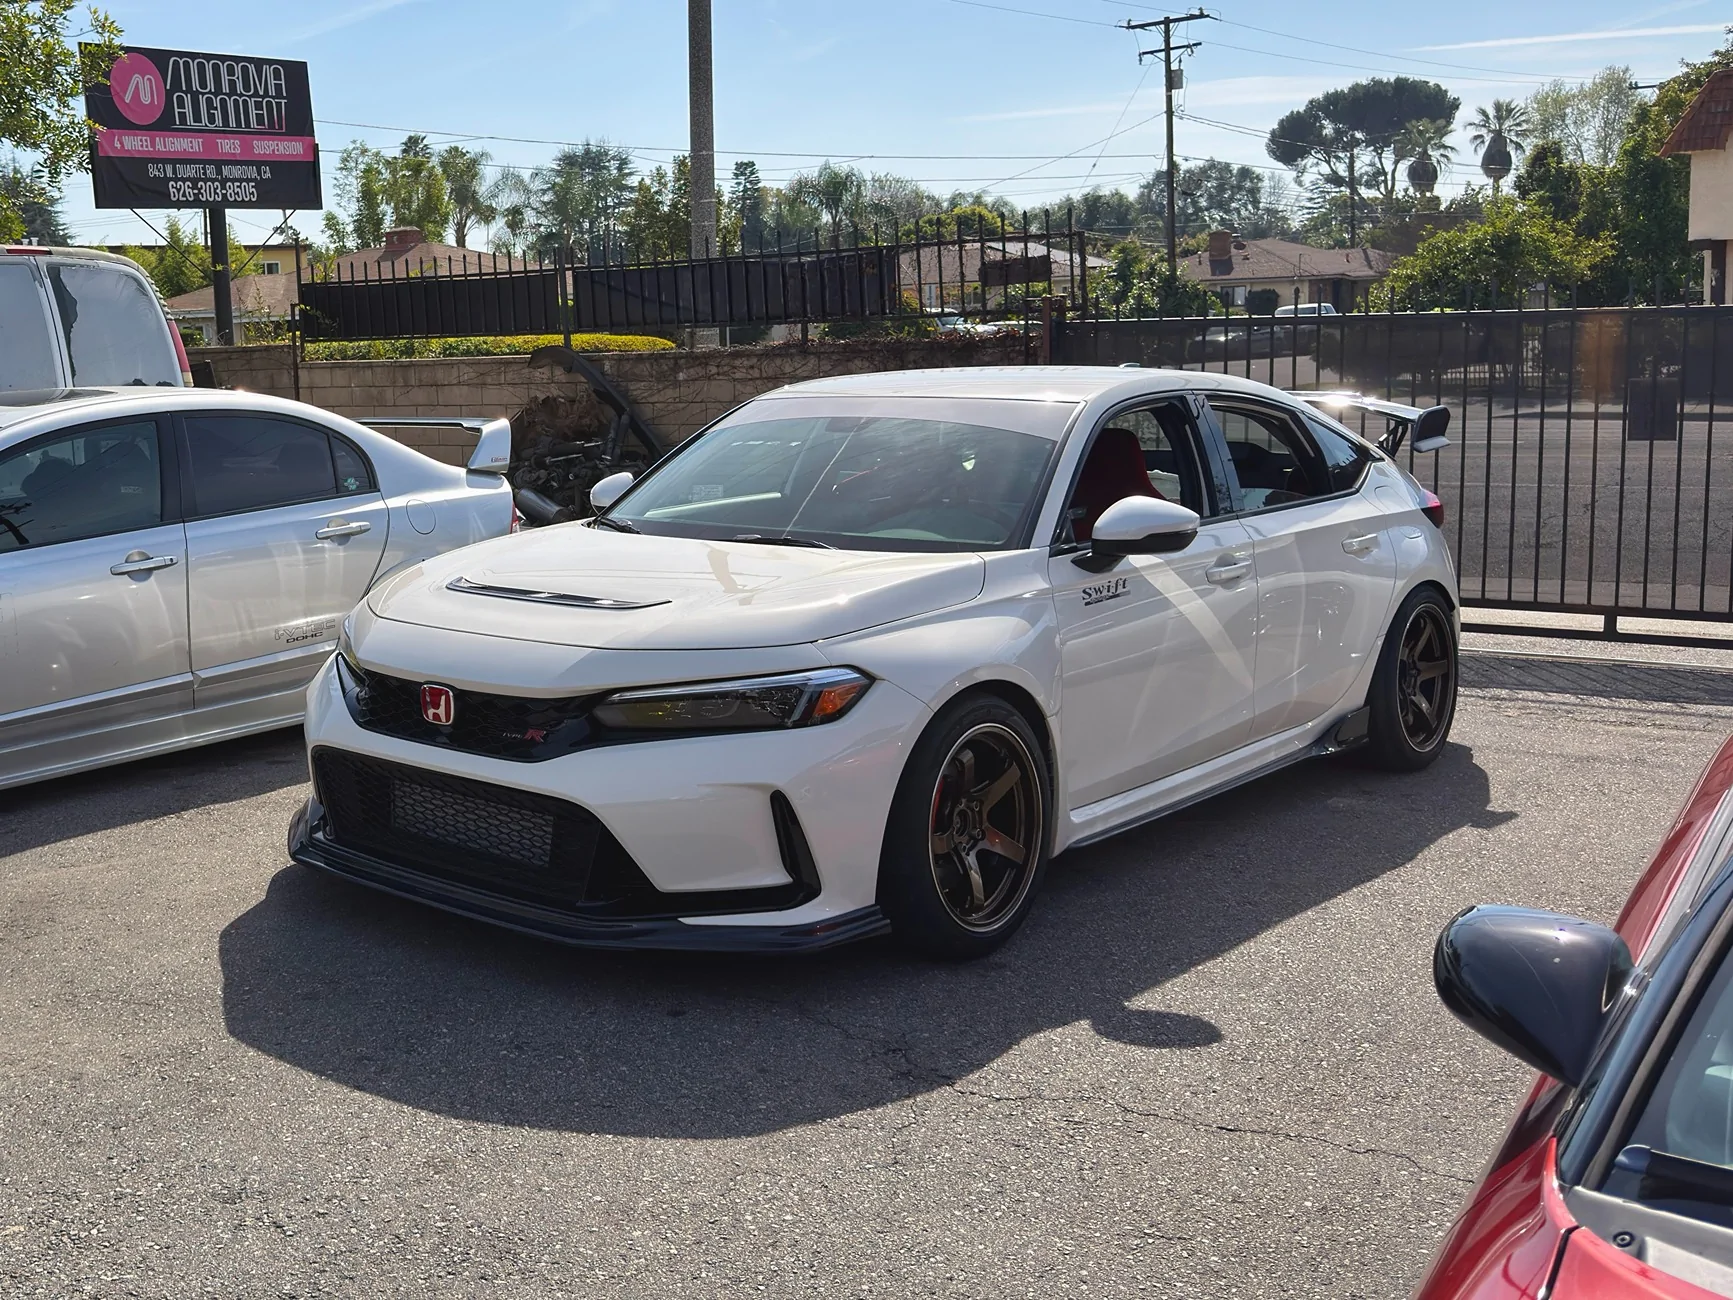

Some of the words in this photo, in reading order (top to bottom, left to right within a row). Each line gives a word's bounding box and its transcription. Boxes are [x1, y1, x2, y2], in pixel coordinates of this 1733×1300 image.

[166, 56, 287, 97] MONROVIA
[172, 92, 288, 132] ALIGNMENT
[114, 135, 121, 149] 4
[122, 136, 153, 151] WHEEL
[155, 137, 203, 153] ALIGNMENT
[216, 139, 241, 154] TIRES
[253, 140, 304, 155] SUSPENSION
[148, 163, 164, 178] 843
[165, 164, 175, 178] W.
[176, 164, 205, 178] DUARTE
[222, 165, 260, 181] MONROVIA,
[261, 166, 272, 179] CA
[168, 181, 257, 202] 626-303-8505
[1081, 577, 1129, 601] Swift
[286, 631, 324, 644] DOHC
